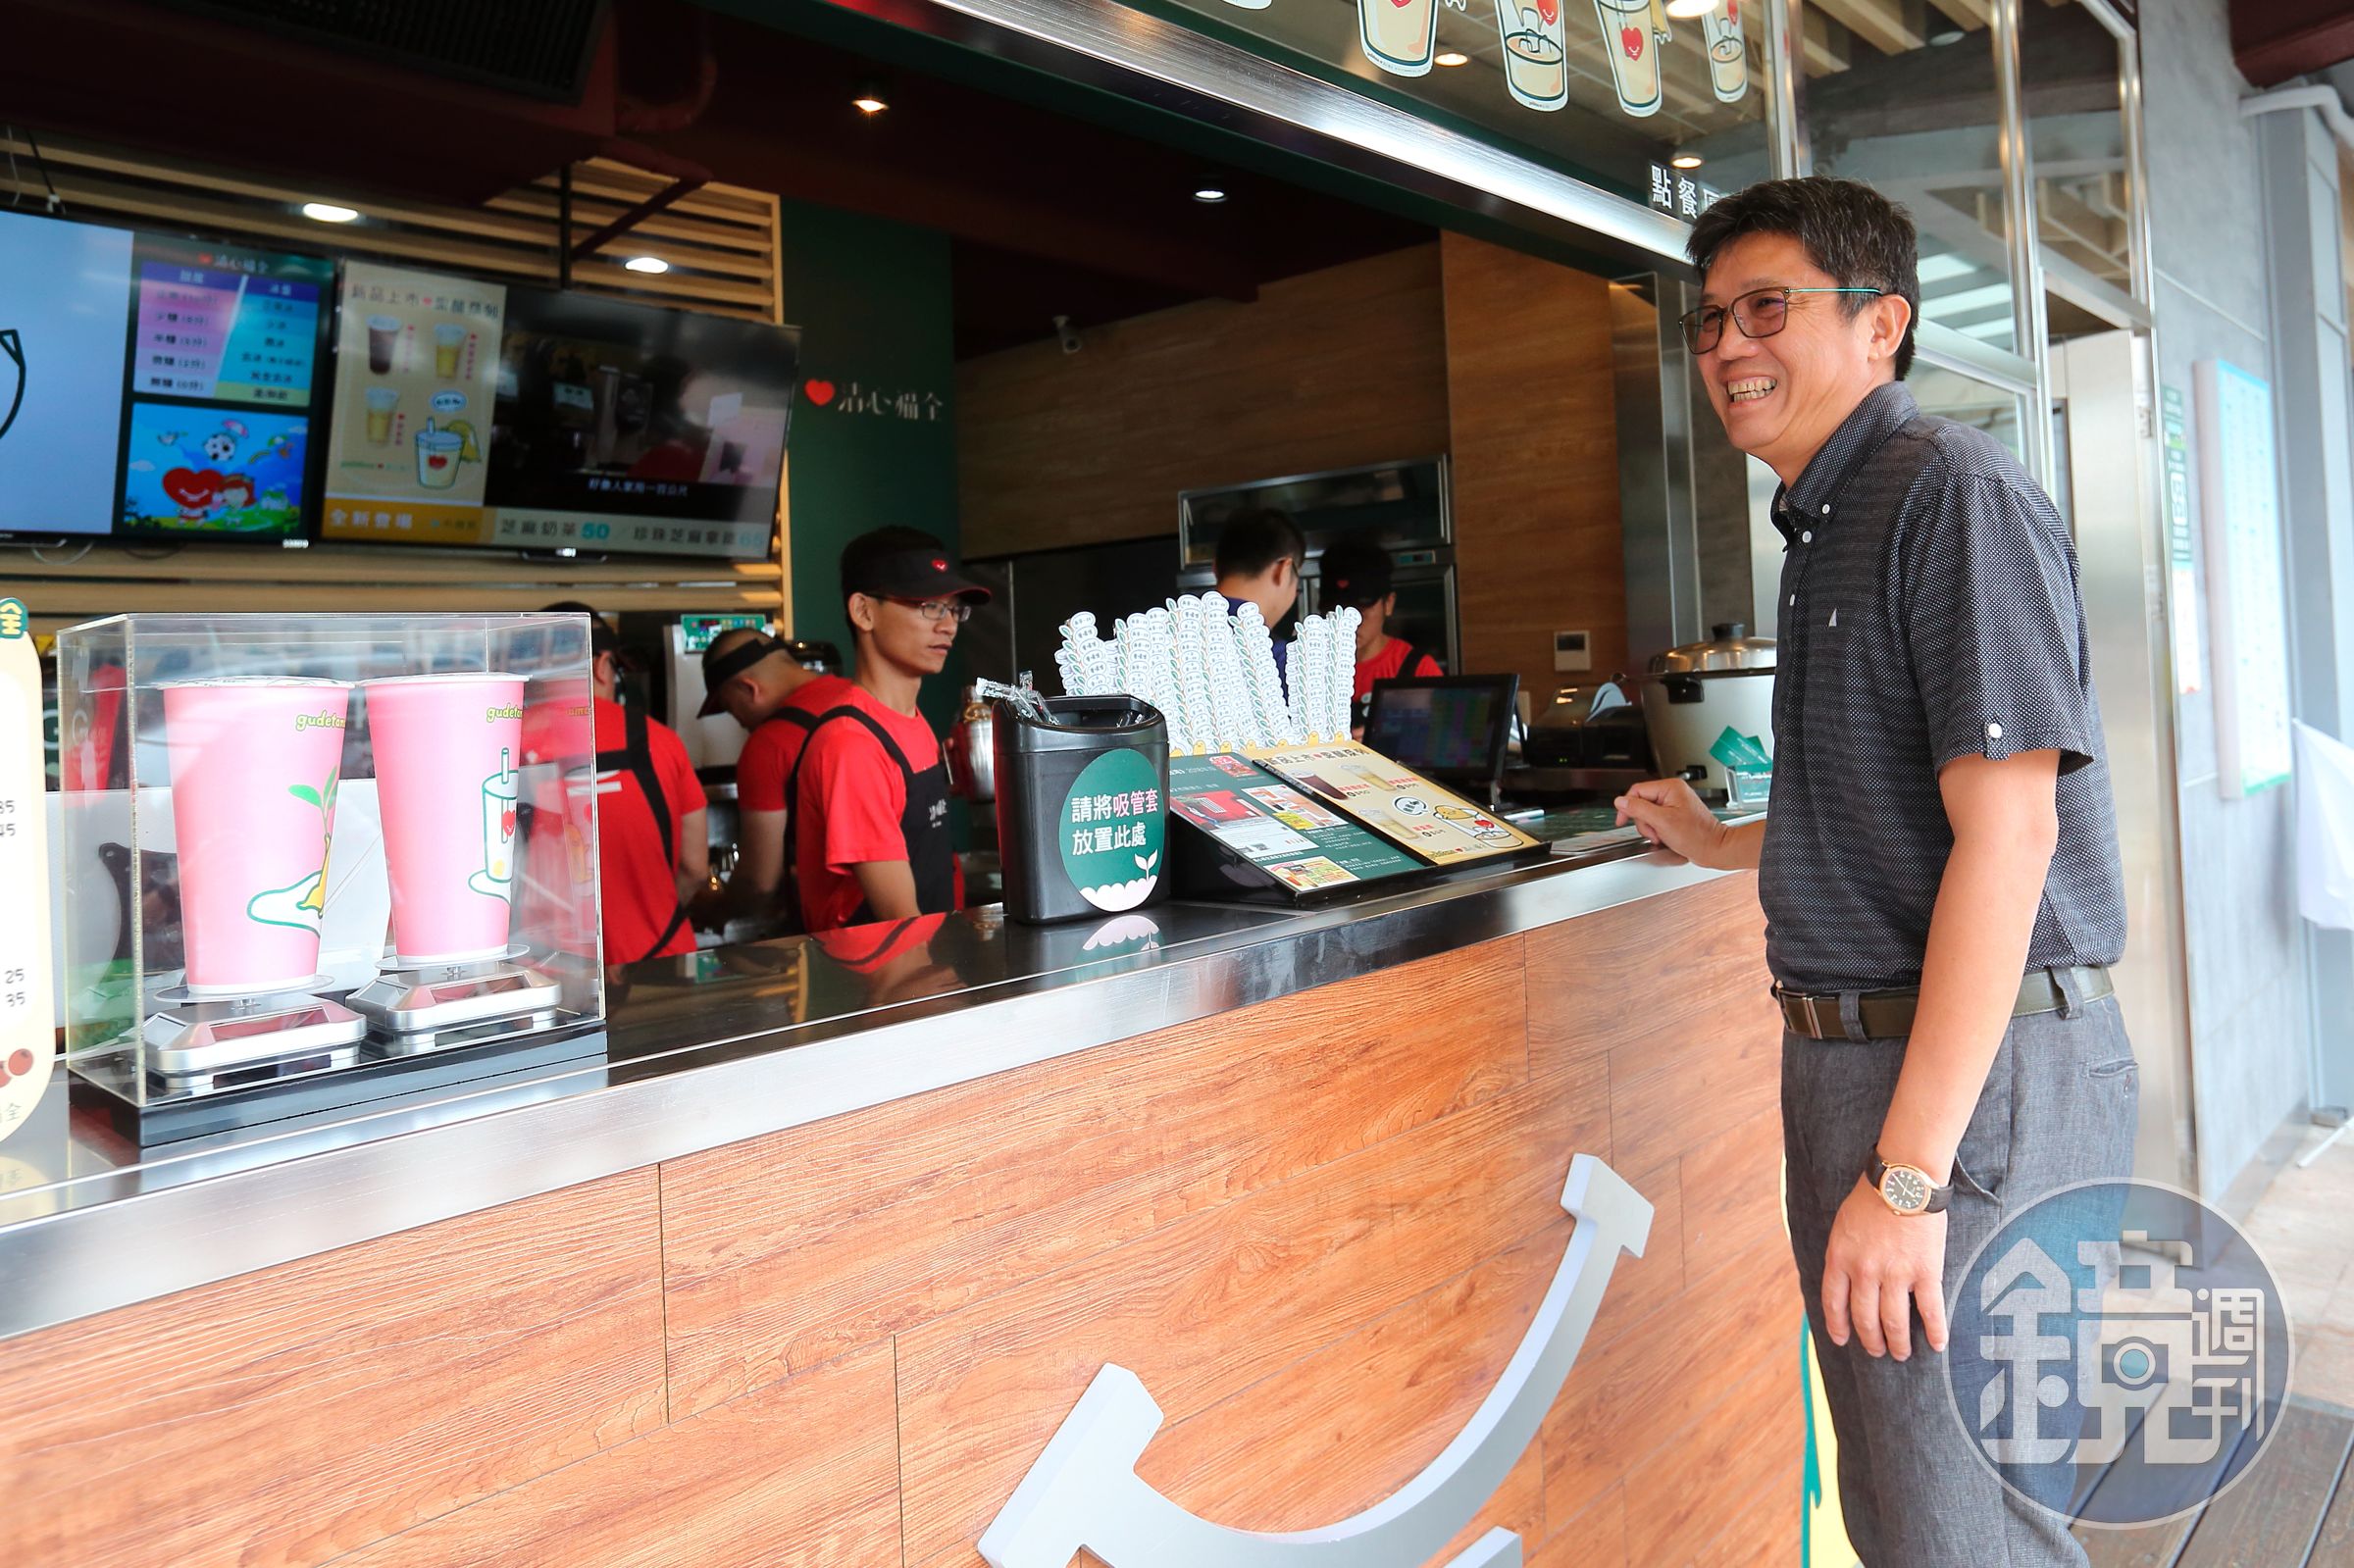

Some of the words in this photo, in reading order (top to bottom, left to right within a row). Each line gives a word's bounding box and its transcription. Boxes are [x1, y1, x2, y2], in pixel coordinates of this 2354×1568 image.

[581, 522, 611, 540] 50
[1071, 787, 1158, 824] 請將吸管套
[1071, 821, 1147, 856] 放置此處
[4, 968, 26, 985] 25
[5, 991, 26, 1007] 35
